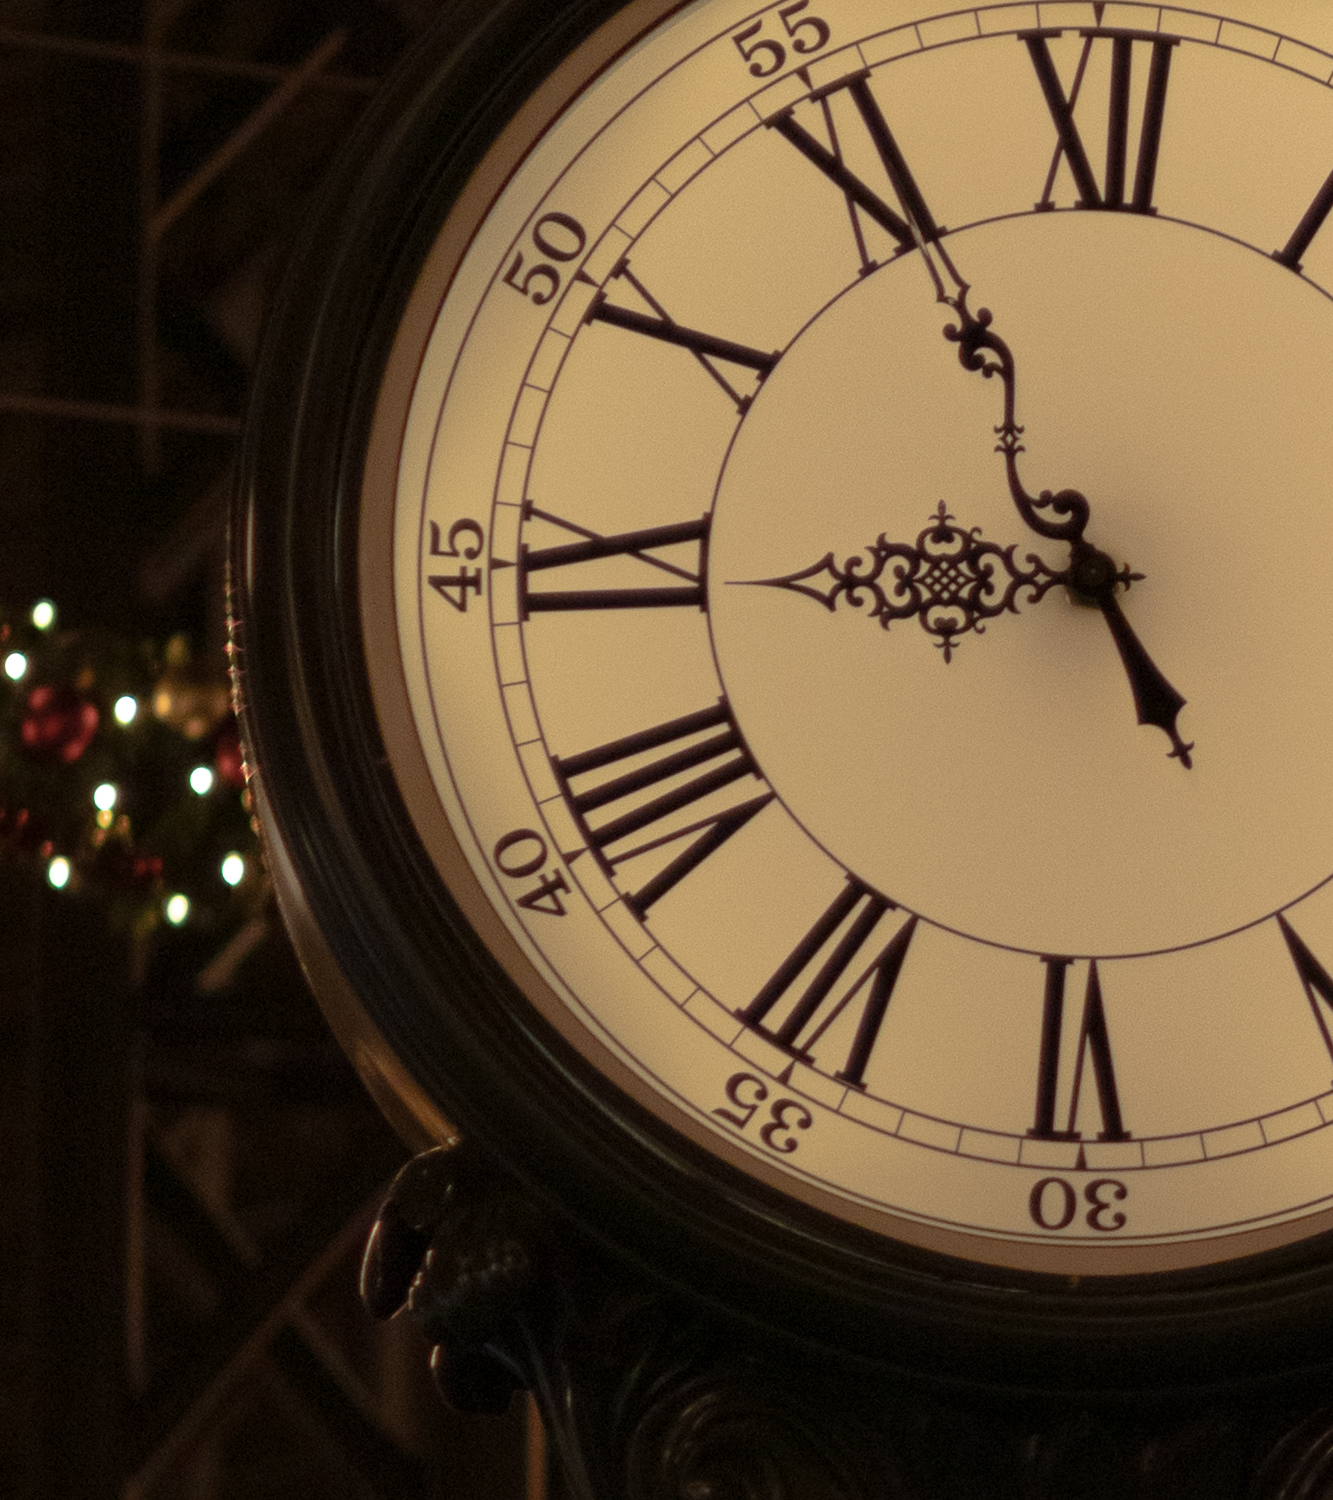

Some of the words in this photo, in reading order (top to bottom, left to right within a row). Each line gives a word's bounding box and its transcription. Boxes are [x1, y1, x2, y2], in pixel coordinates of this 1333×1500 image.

[765, 70, 948, 278] XI
[1018, 30, 1180, 212] XII
[500, 210, 588, 308] 50
[582, 259, 782, 415] X
[426, 516, 486, 615] 45
[518, 500, 710, 620] IX
[491, 827, 574, 919] 40
[550, 696, 778, 921] VIII
[734, 874, 920, 1090] VII
[1025, 955, 1132, 1142] VI
[710, 1070, 815, 1156] 35
[1027, 1175, 1130, 1234] 30
